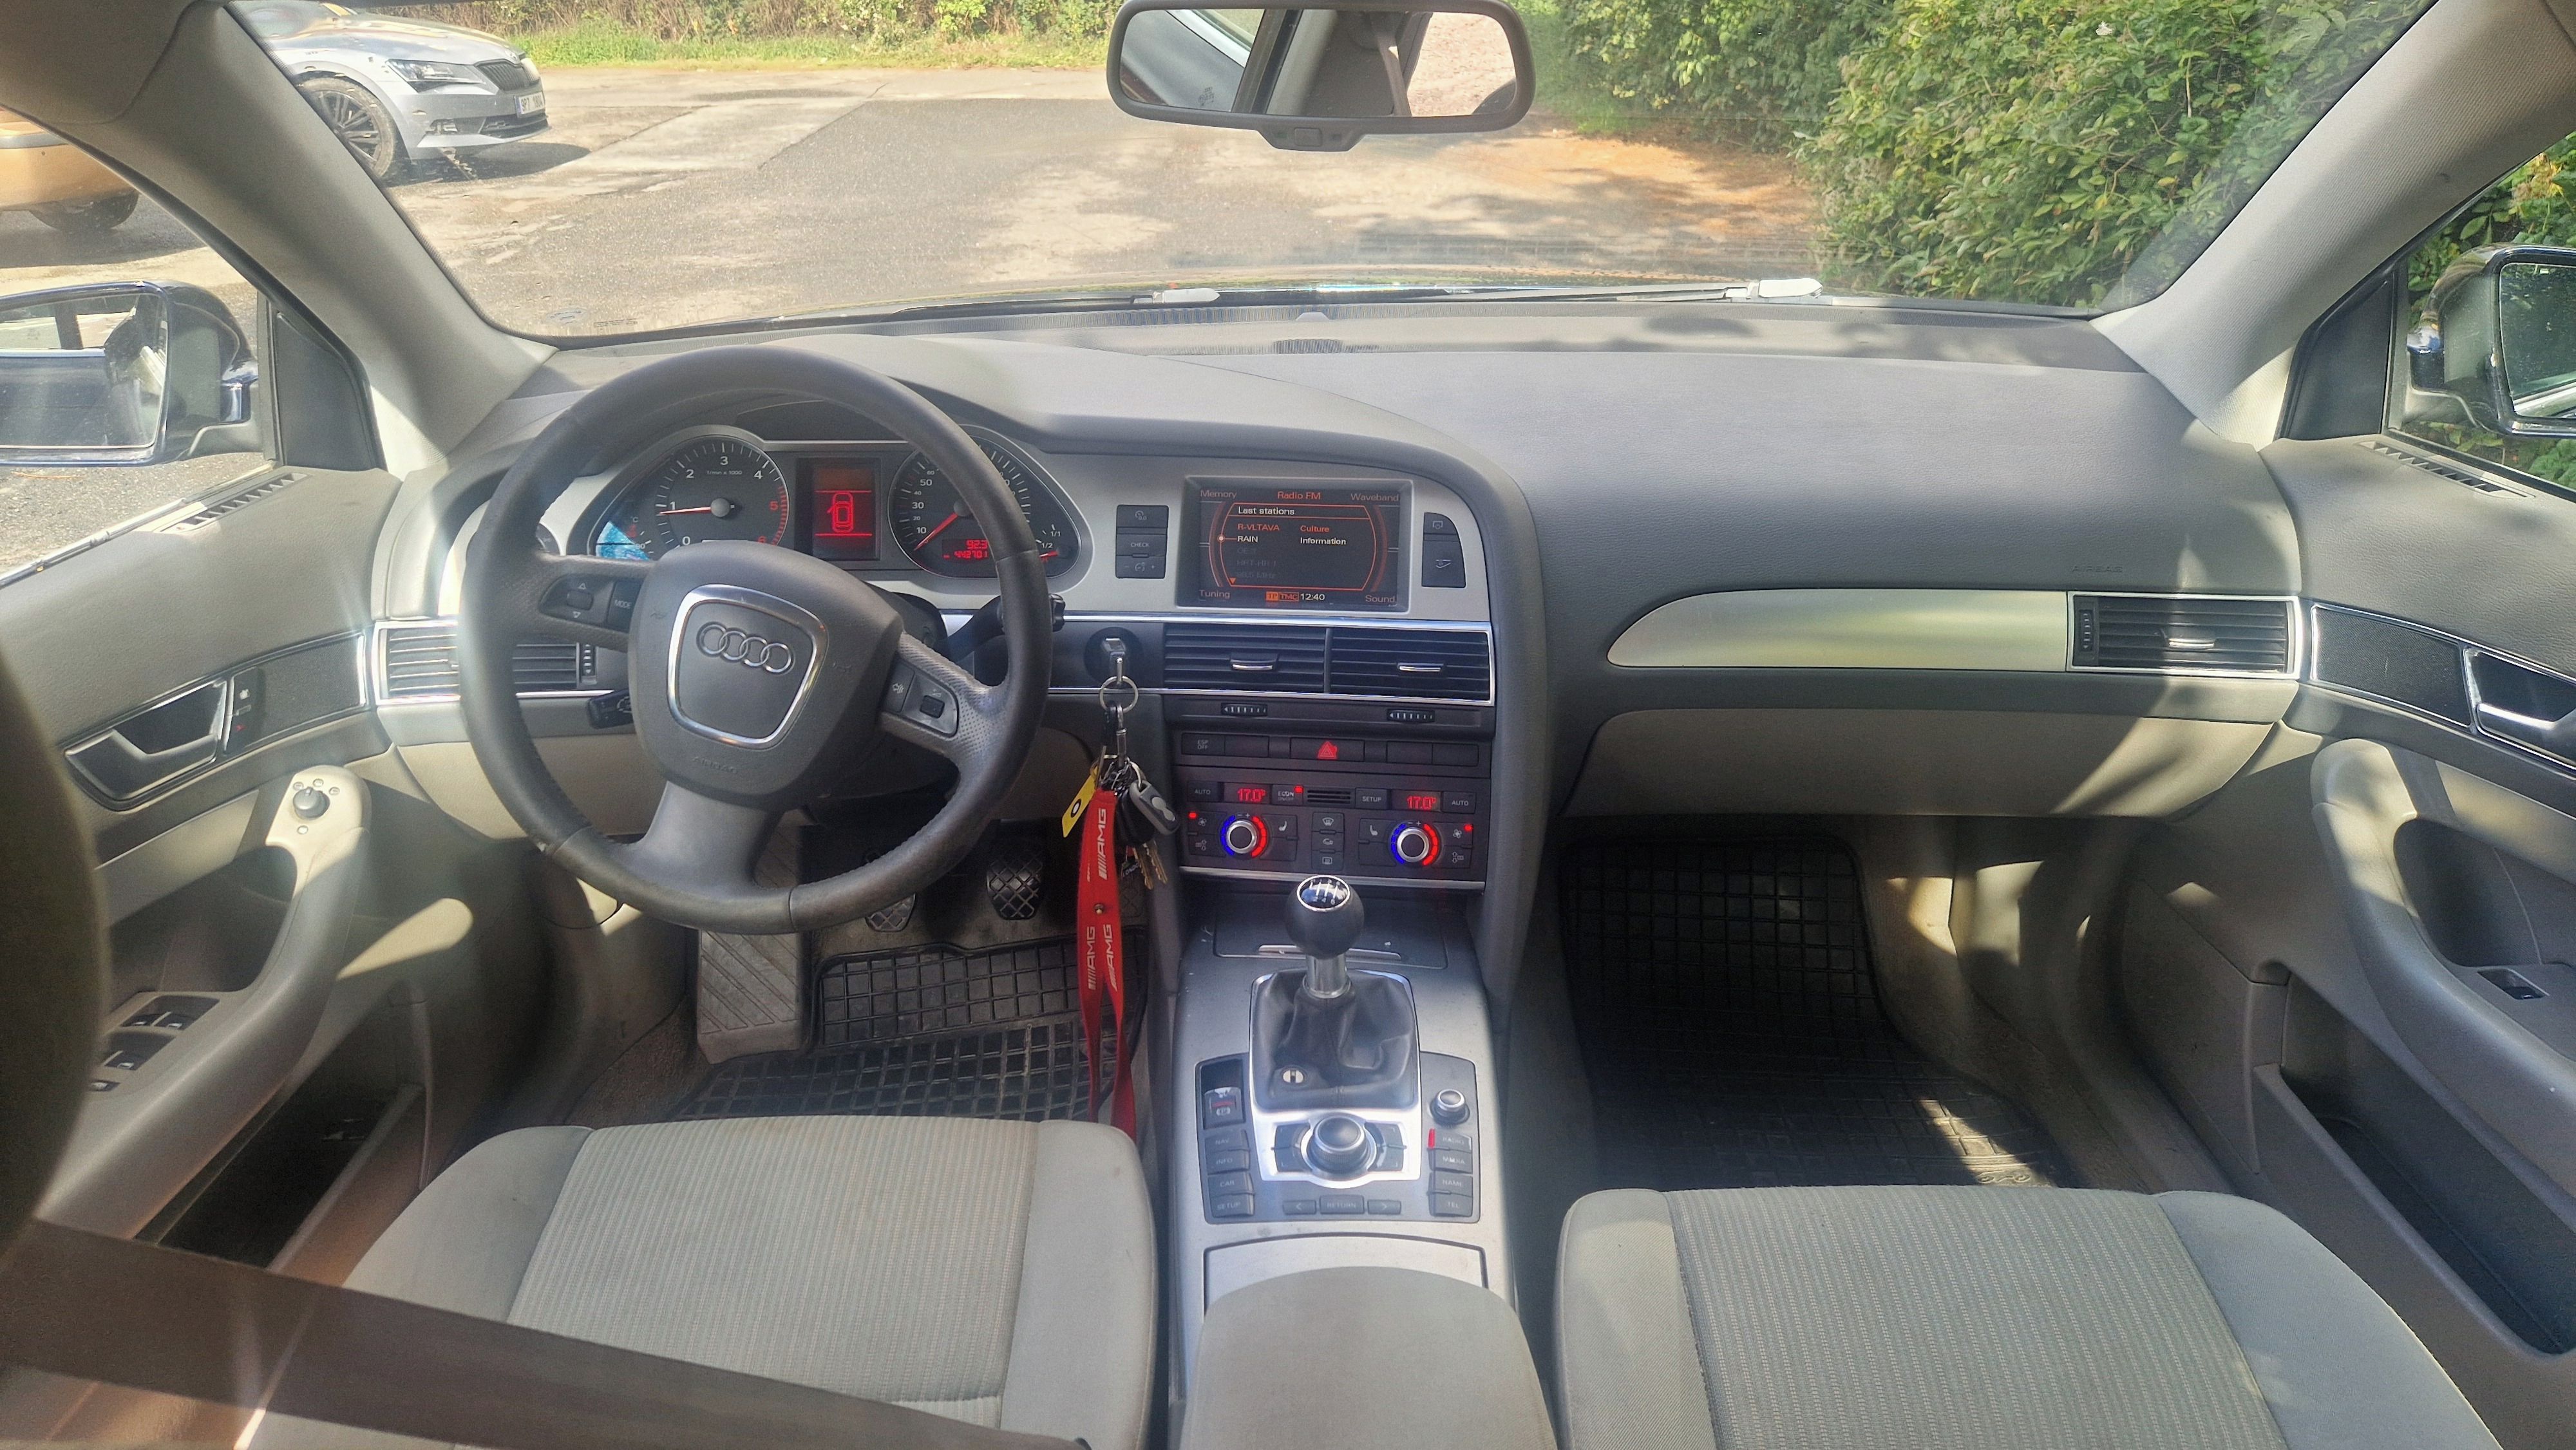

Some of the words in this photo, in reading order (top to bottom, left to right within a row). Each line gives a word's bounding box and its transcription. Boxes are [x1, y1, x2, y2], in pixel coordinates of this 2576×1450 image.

[720, 456, 728, 465] 3
[686, 469, 694, 478] 2
[754, 470, 762, 479] 4
[1200, 489, 1237, 499] Memory
[1278, 491, 1303, 500] Radio
[1350, 493, 1399, 502] Waveband
[1259, 507, 1294, 516] stations
[682, 536, 690, 545] 0
[1300, 537, 1346, 545] Information
[1199, 589, 1231, 599] Tuning
[1365, 595, 1395, 603] Sound
[1217, 1201, 1240, 1210] SETUP
